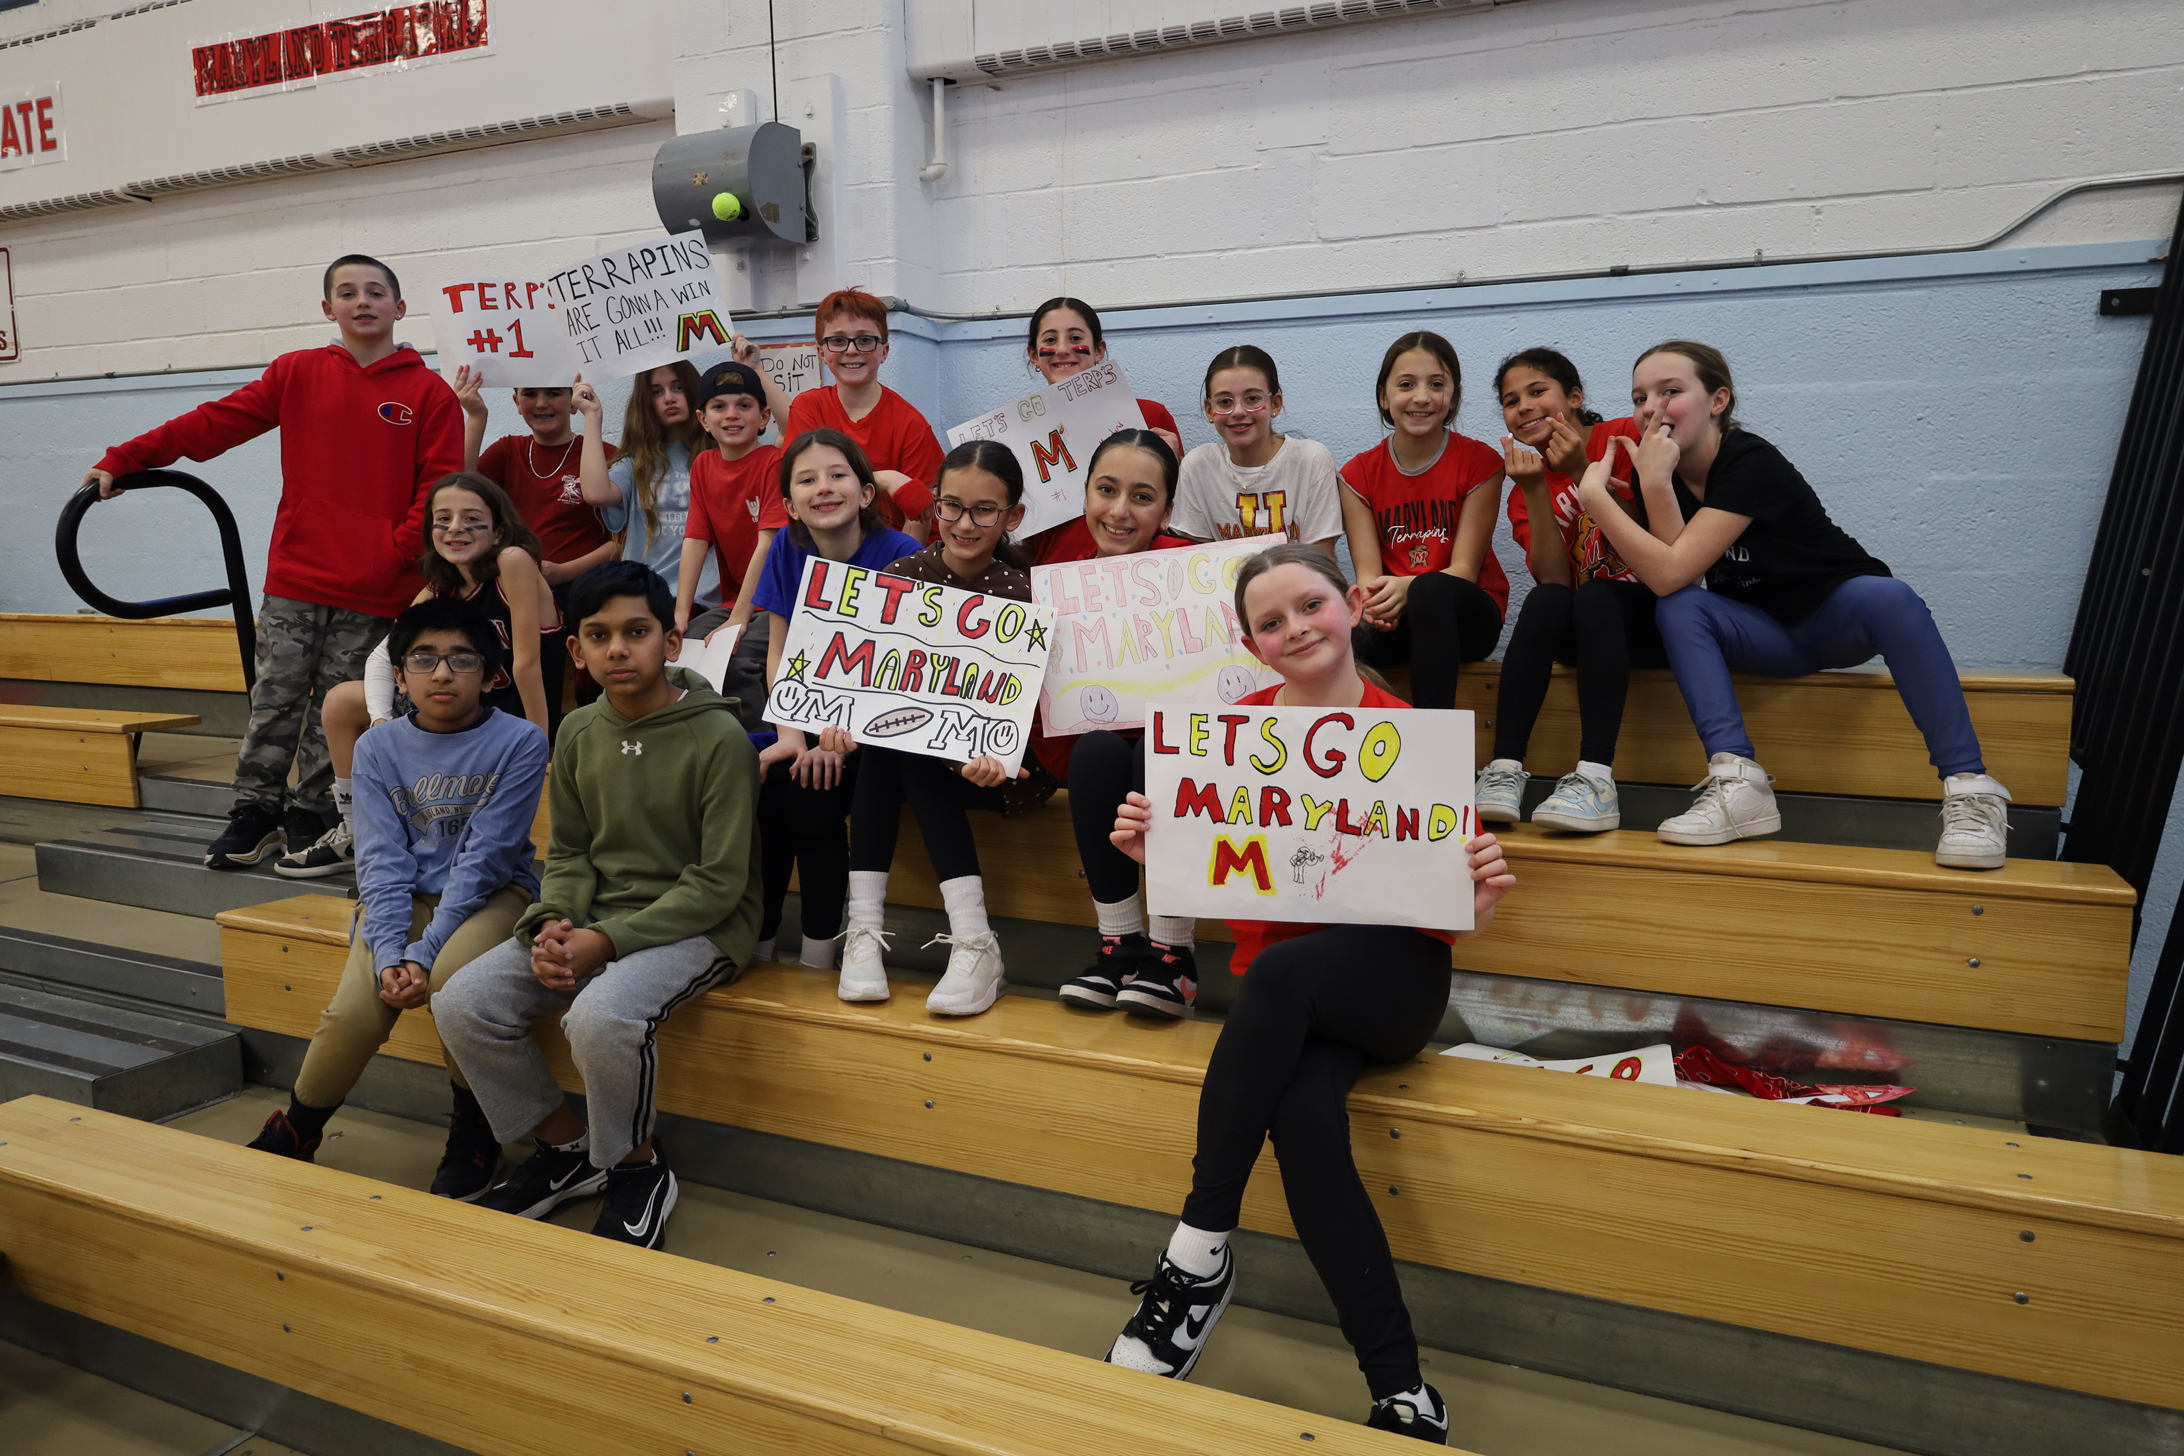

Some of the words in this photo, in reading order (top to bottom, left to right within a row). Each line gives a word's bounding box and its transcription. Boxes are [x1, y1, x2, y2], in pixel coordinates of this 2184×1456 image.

[199, 25, 326, 94] MARYLAND
[548, 239, 711, 303] TERRAPINS
[467, 318, 534, 359] #1
[566, 303, 600, 337] ARE
[605, 288, 669, 326] GONNA
[671, 280, 712, 305] WIN
[676, 309, 731, 353] M
[576, 334, 601, 364] IT
[614, 318, 666, 354] ALL!!!
[760, 357, 784, 372] DO
[792, 353, 817, 371] NOT
[958, 412, 1008, 444] LET'S
[1017, 394, 1047, 422] GO
[1057, 363, 1118, 402] TERP'S
[1051, 488, 1067, 502] #1
[1387, 525, 1449, 549] Terrapins
[803, 560, 943, 628] LET'S
[956, 594, 1027, 644] GO
[1050, 558, 1162, 616] LET'S
[813, 631, 1022, 706] MARYLAND
[1153, 711, 1288, 775] LETS
[1303, 712, 1401, 782] GO
[1174, 777, 1469, 844] MARYLAND!
[1207, 833, 1277, 896] M
